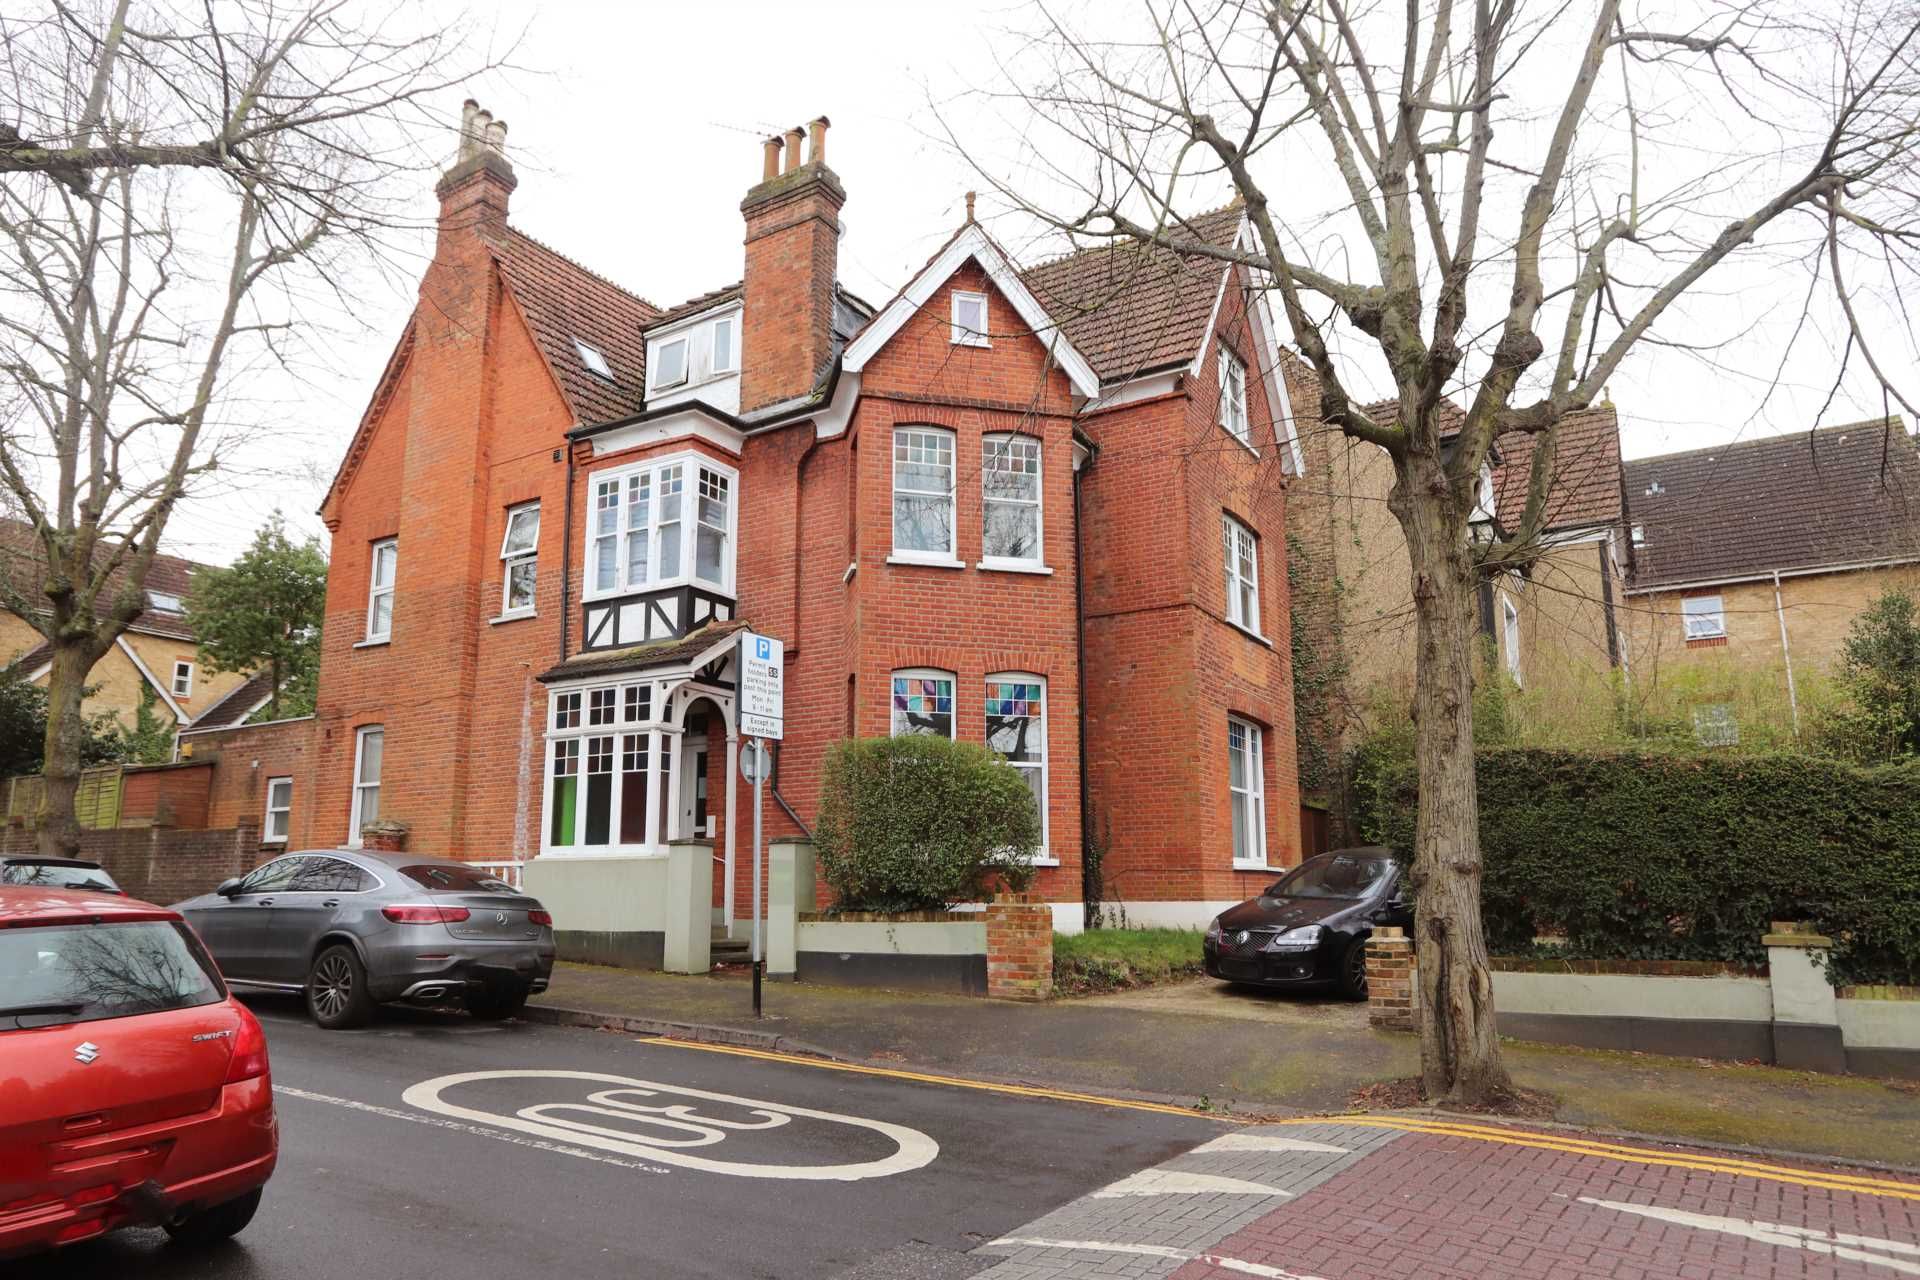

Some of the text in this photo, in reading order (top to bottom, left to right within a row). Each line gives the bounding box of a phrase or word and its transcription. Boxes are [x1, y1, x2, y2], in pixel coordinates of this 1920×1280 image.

[759, 639, 769, 657] P
[748, 660, 767, 669] Permit
[747, 667, 767, 678] holders
[746, 677, 779, 689] parking only
[757, 685, 767, 694] this
[768, 688, 782, 697] point
[752, 694, 775, 704] Mon Fri
[750, 717, 769, 727] Except
[746, 725, 778, 737] signed bays
[191, 1030, 233, 1042] SWIFT
